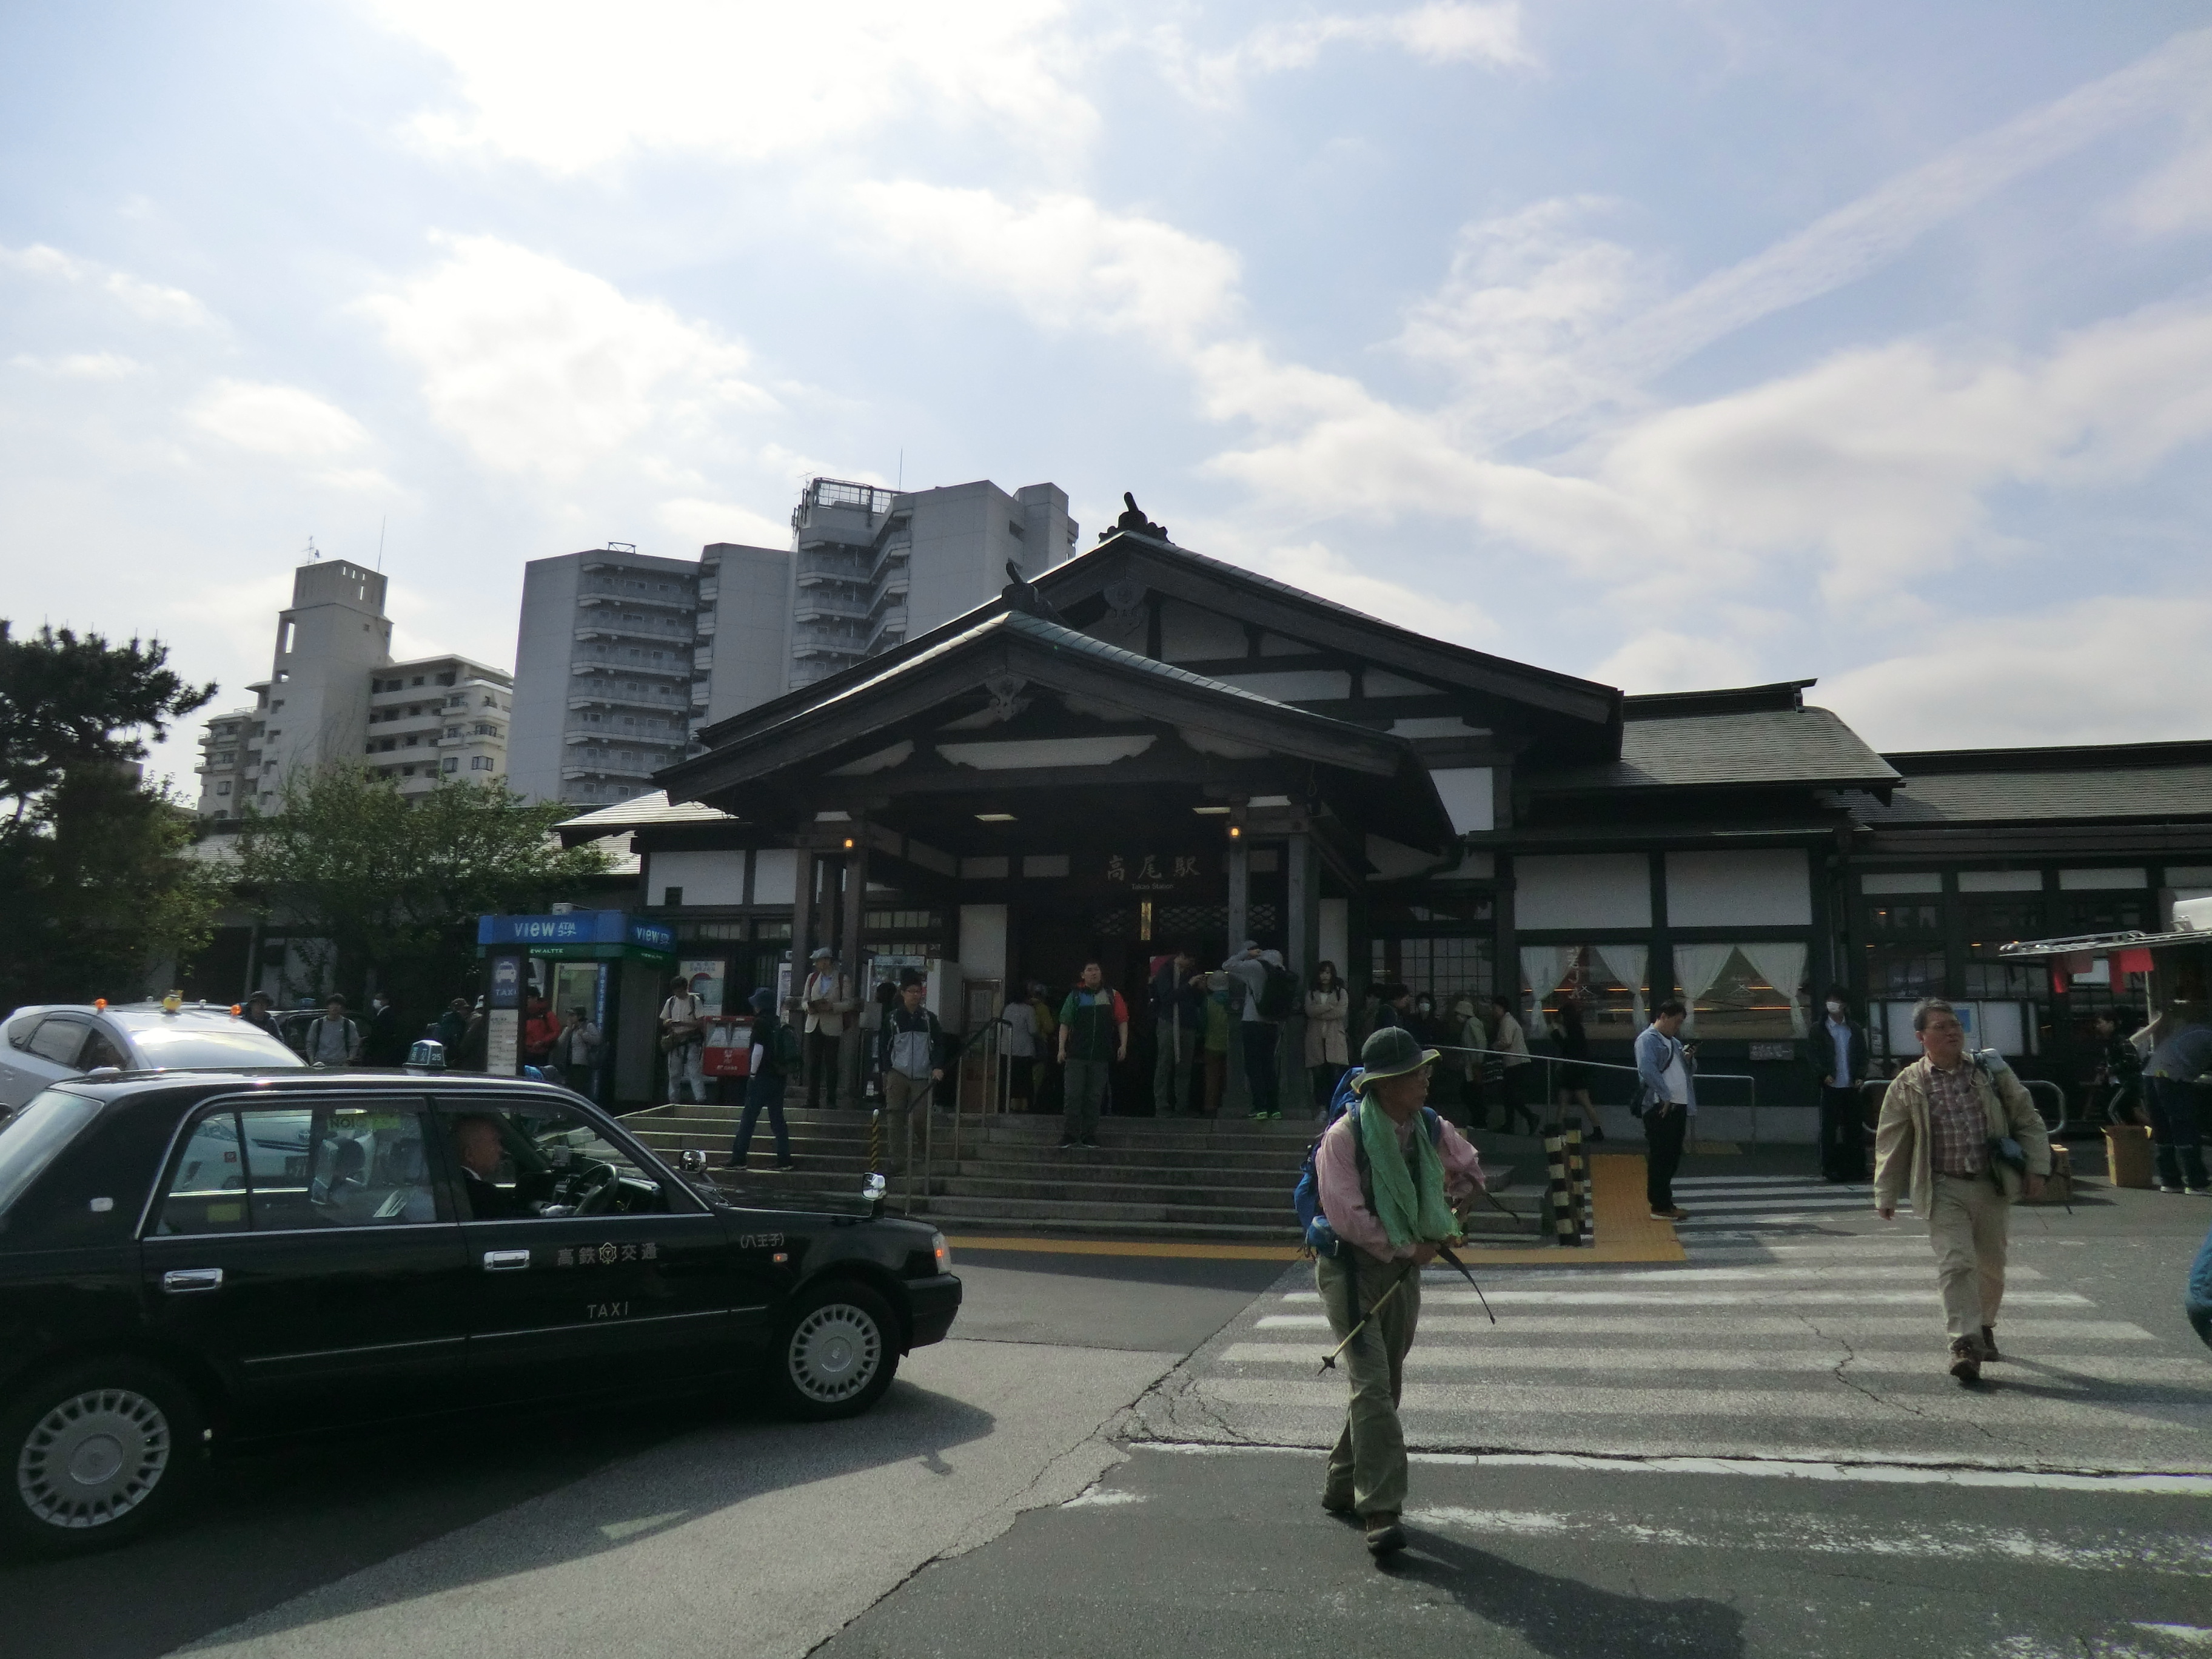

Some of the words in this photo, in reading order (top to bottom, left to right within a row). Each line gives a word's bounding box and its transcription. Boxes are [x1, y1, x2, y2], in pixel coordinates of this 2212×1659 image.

[1107, 854, 1201, 882] 高尾駅
[558, 922, 575, 930] ATM
[587, 1301, 629, 1319] TAXI
